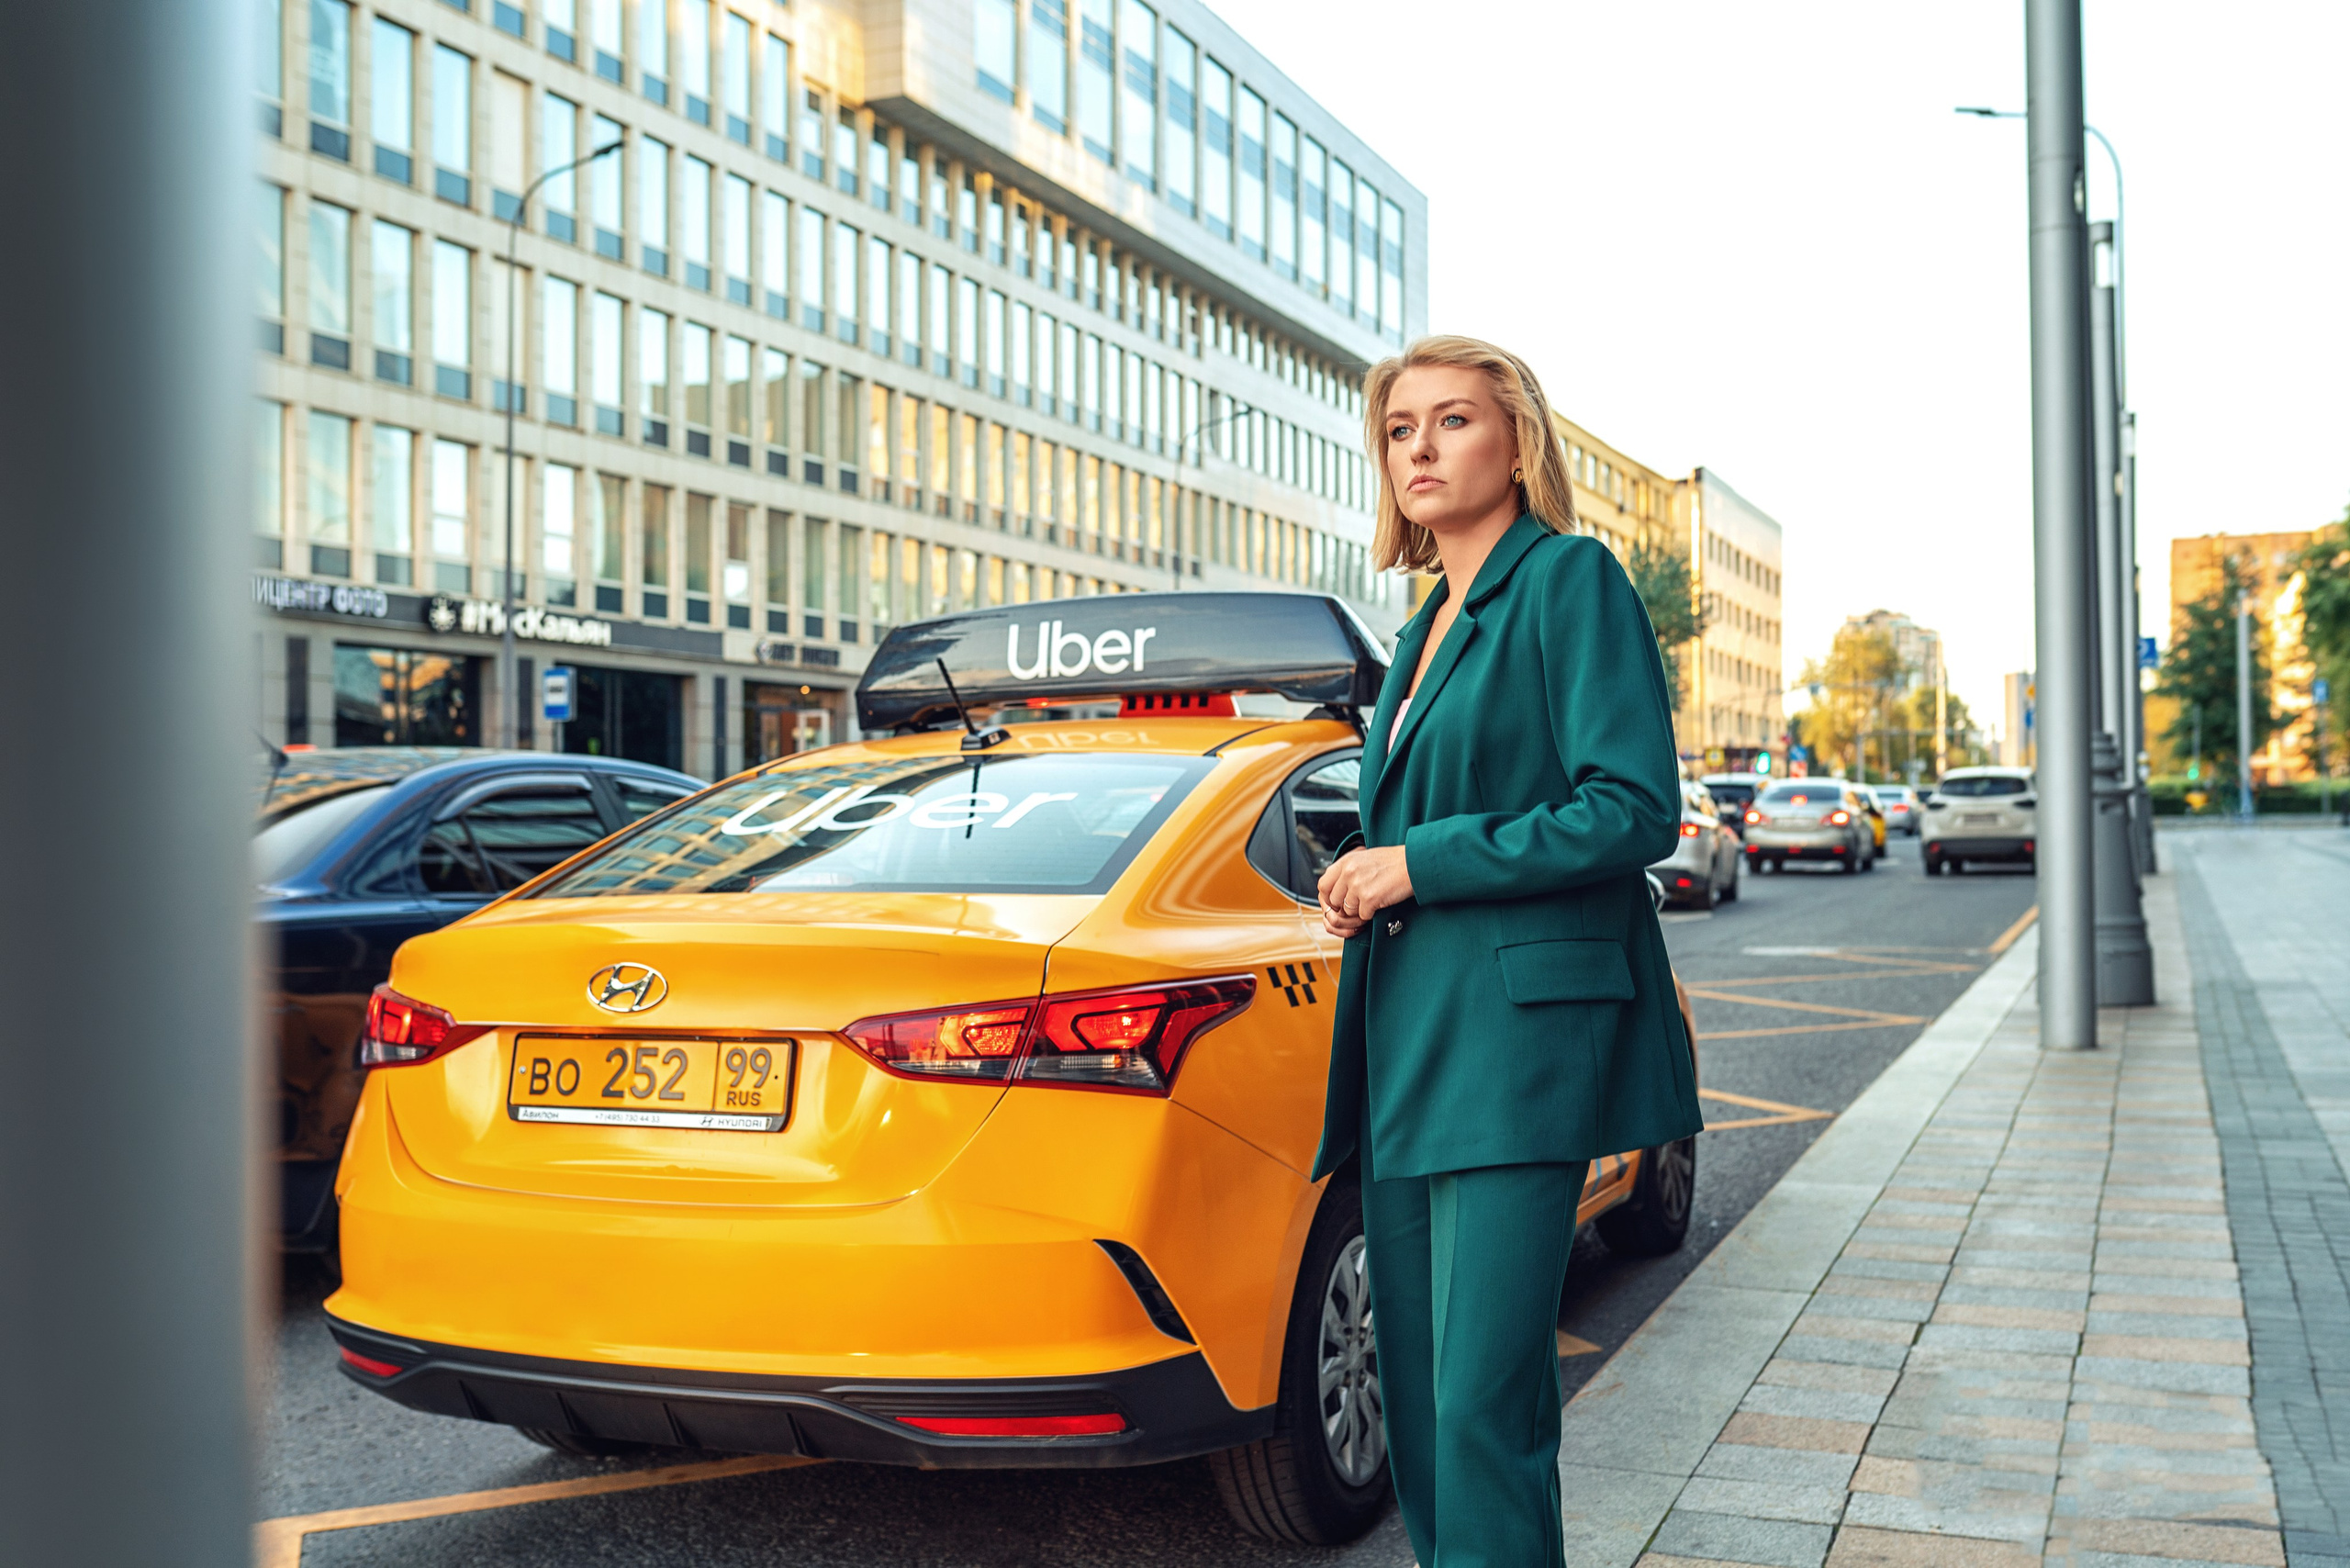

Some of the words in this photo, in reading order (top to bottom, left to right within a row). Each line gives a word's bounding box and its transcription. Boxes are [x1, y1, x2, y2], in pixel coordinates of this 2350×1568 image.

[1008, 620, 1157, 681] Uber
[721, 784, 1079, 835] Uber
[601, 1047, 688, 1100] 252
[725, 1047, 772, 1089] 99
[726, 1091, 761, 1106] RUS
[718, 1118, 763, 1128] HYUNDAI
